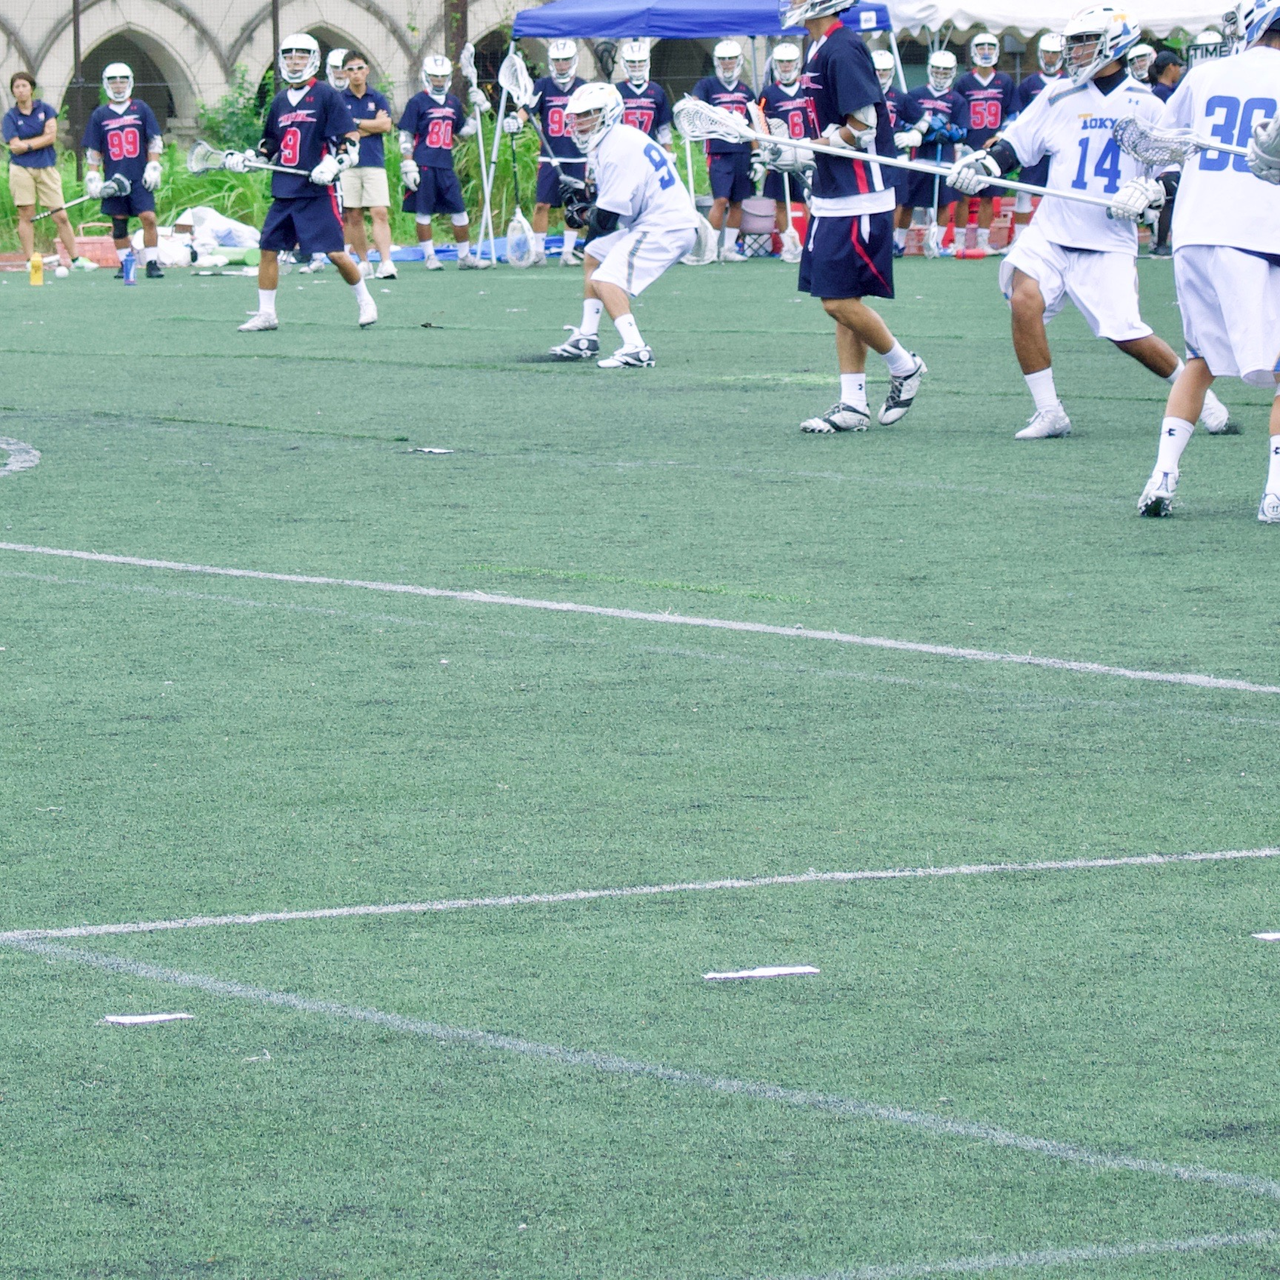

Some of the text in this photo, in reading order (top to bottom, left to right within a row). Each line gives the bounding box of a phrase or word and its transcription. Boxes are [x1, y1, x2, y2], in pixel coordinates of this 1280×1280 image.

[622, 109, 655, 135] 57
[970, 100, 1002, 129] 59
[1077, 113, 1122, 130] TOKY
[107, 127, 140, 161] 99
[280, 126, 301, 167] 9
[426, 118, 454, 150] 80
[1199, 95, 1277, 173] 36
[643, 143, 676, 190] 9
[1071, 137, 1122, 195] 14
